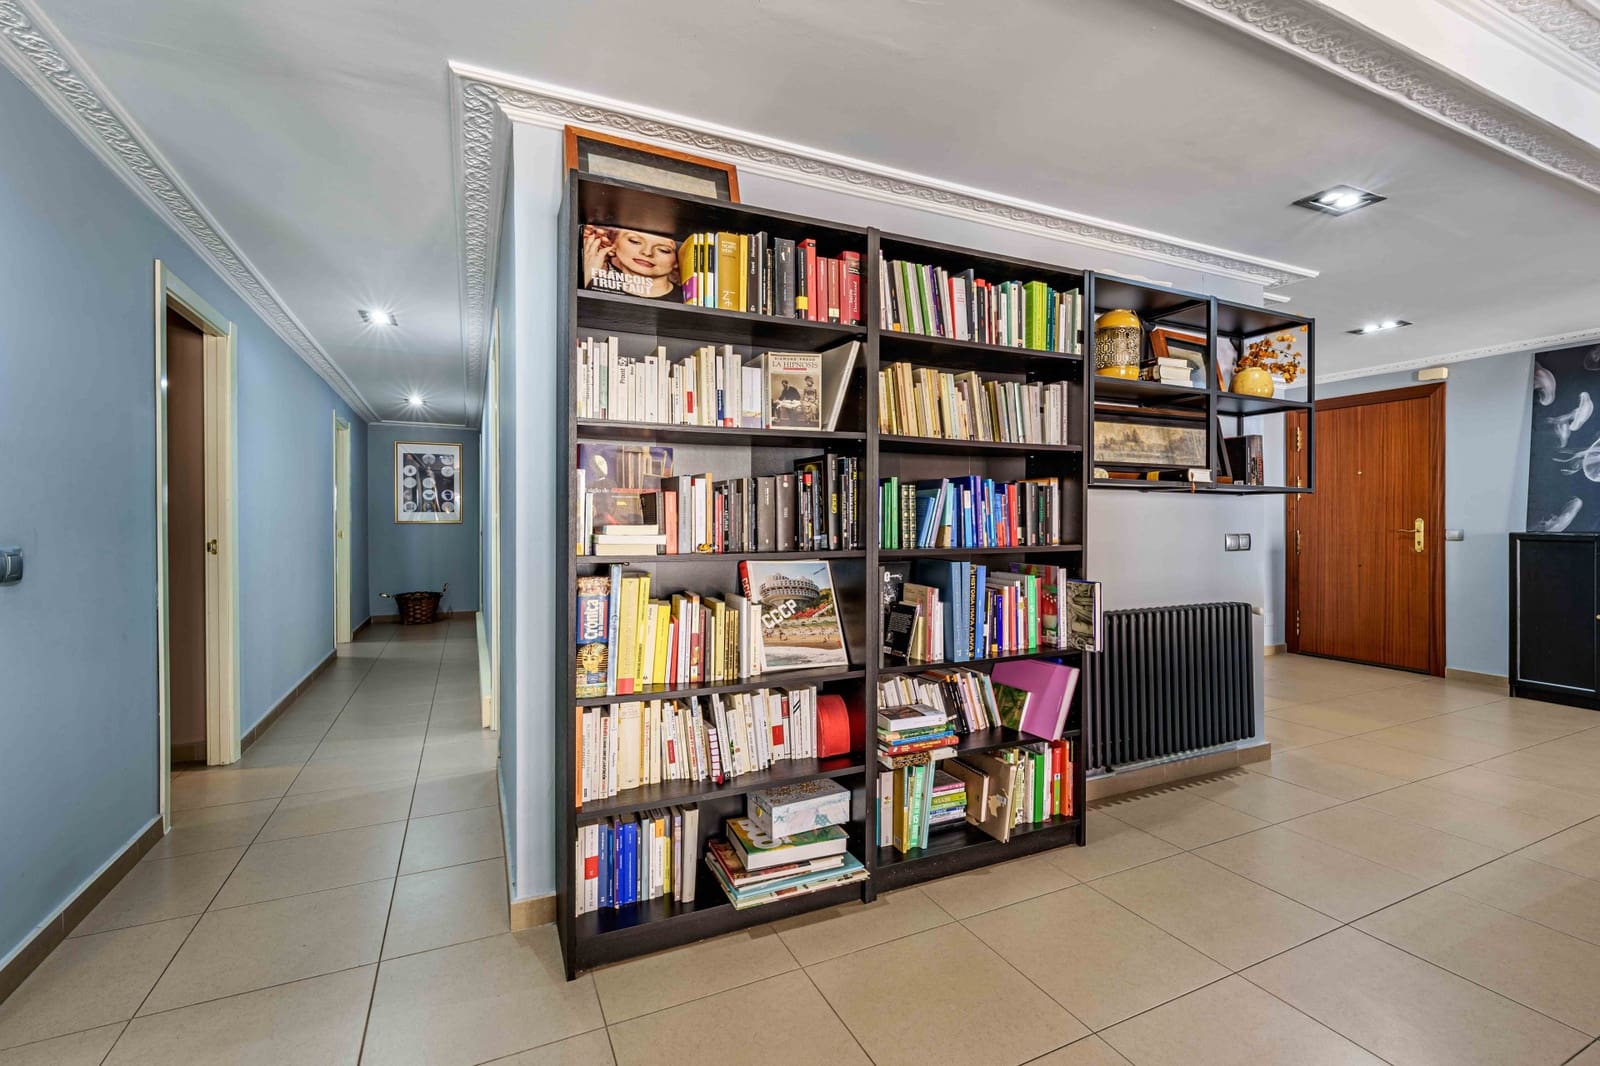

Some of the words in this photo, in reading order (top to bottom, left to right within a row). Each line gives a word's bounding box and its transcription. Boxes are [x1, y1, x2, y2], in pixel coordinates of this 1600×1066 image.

[592, 277, 653, 296] TRUFFAUT
[772, 360, 781, 368] LA
[783, 361, 818, 369] HIPNOSIS
[761, 599, 798, 629] CCCP
